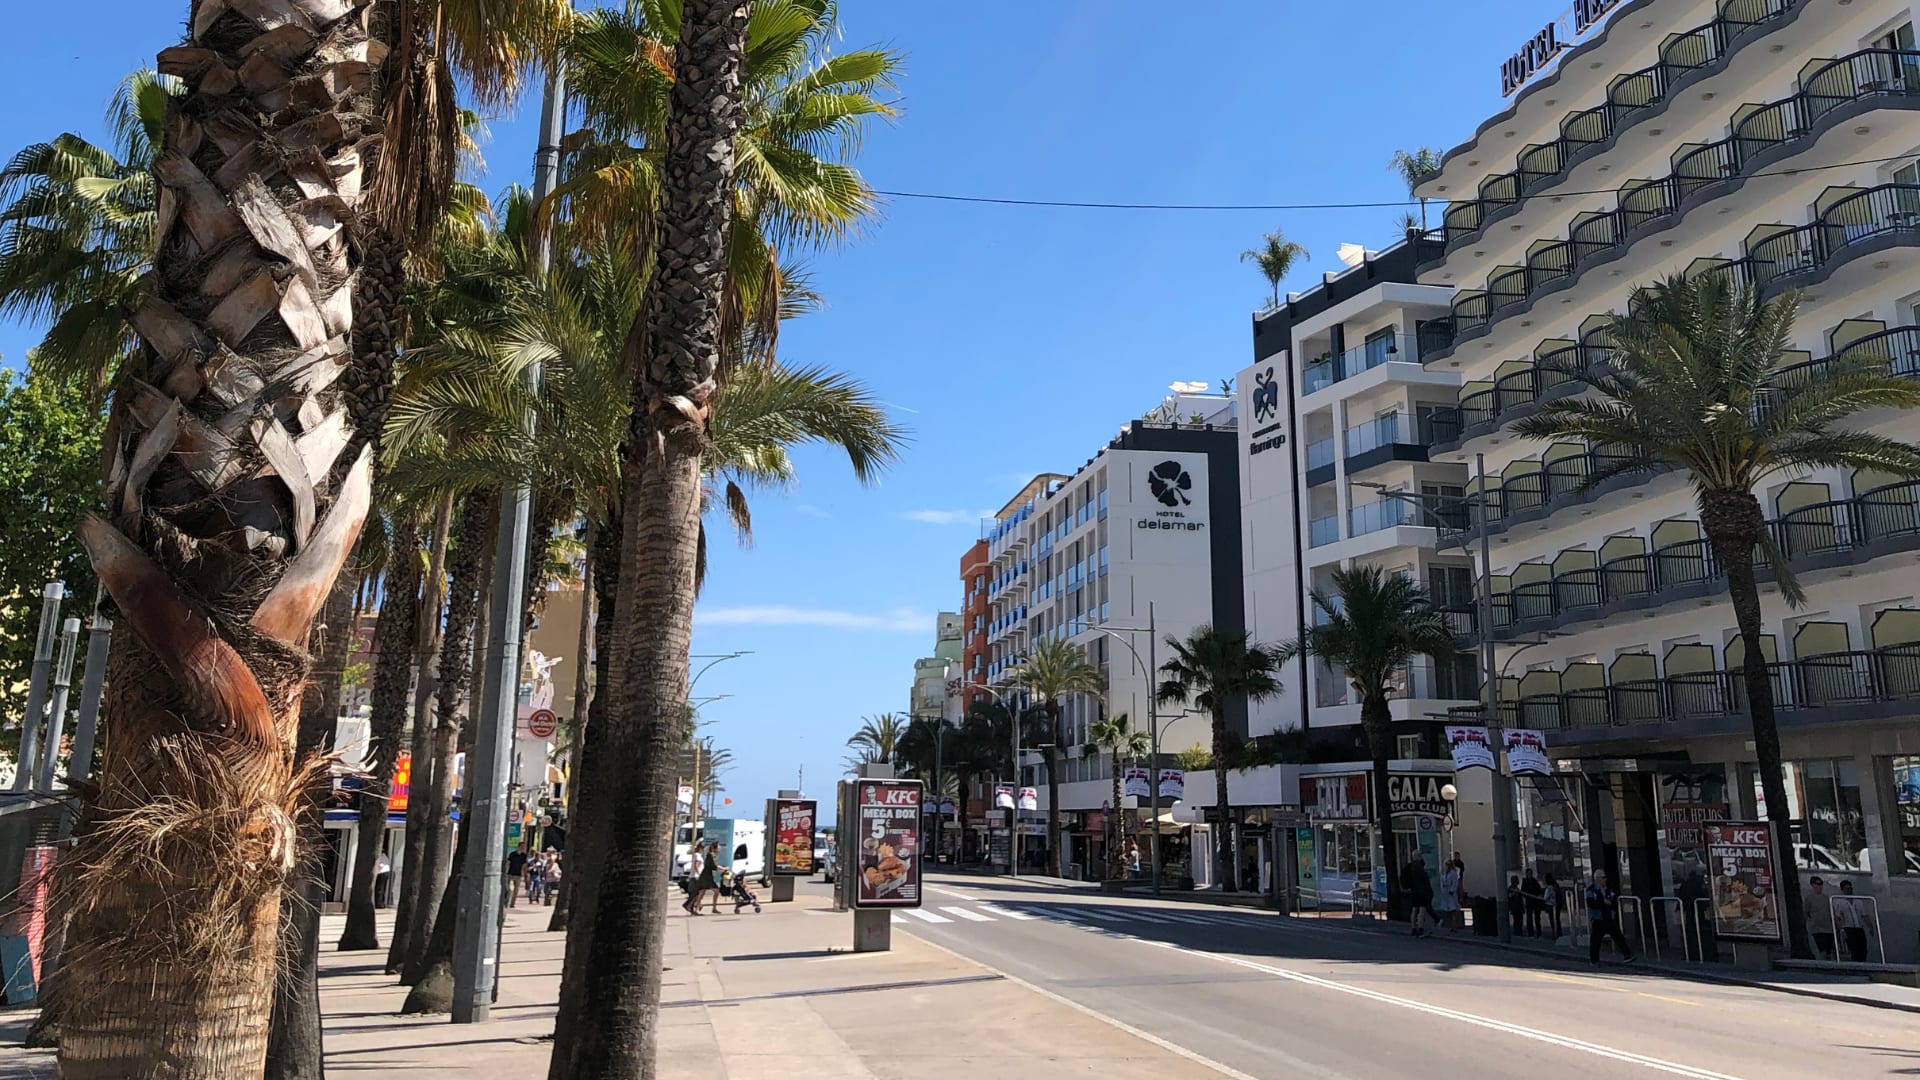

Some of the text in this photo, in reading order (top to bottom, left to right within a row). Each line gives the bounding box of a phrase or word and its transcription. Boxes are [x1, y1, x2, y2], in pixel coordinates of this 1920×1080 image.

[1500, 22, 1561, 97] HOTEL
[1137, 518, 1205, 531] delamar
[1387, 776, 1441, 802] GALA
[885, 790, 917, 804] KFC
[863, 808, 916, 819] MEGA BOX
[1390, 802, 1447, 814] ISCO CLUB
[1664, 807, 1687, 823] HOTEL
[1668, 828, 1699, 843] LLORET
[1732, 830, 1765, 844] KFC
[1711, 847, 1766, 858] MEGA BOX
